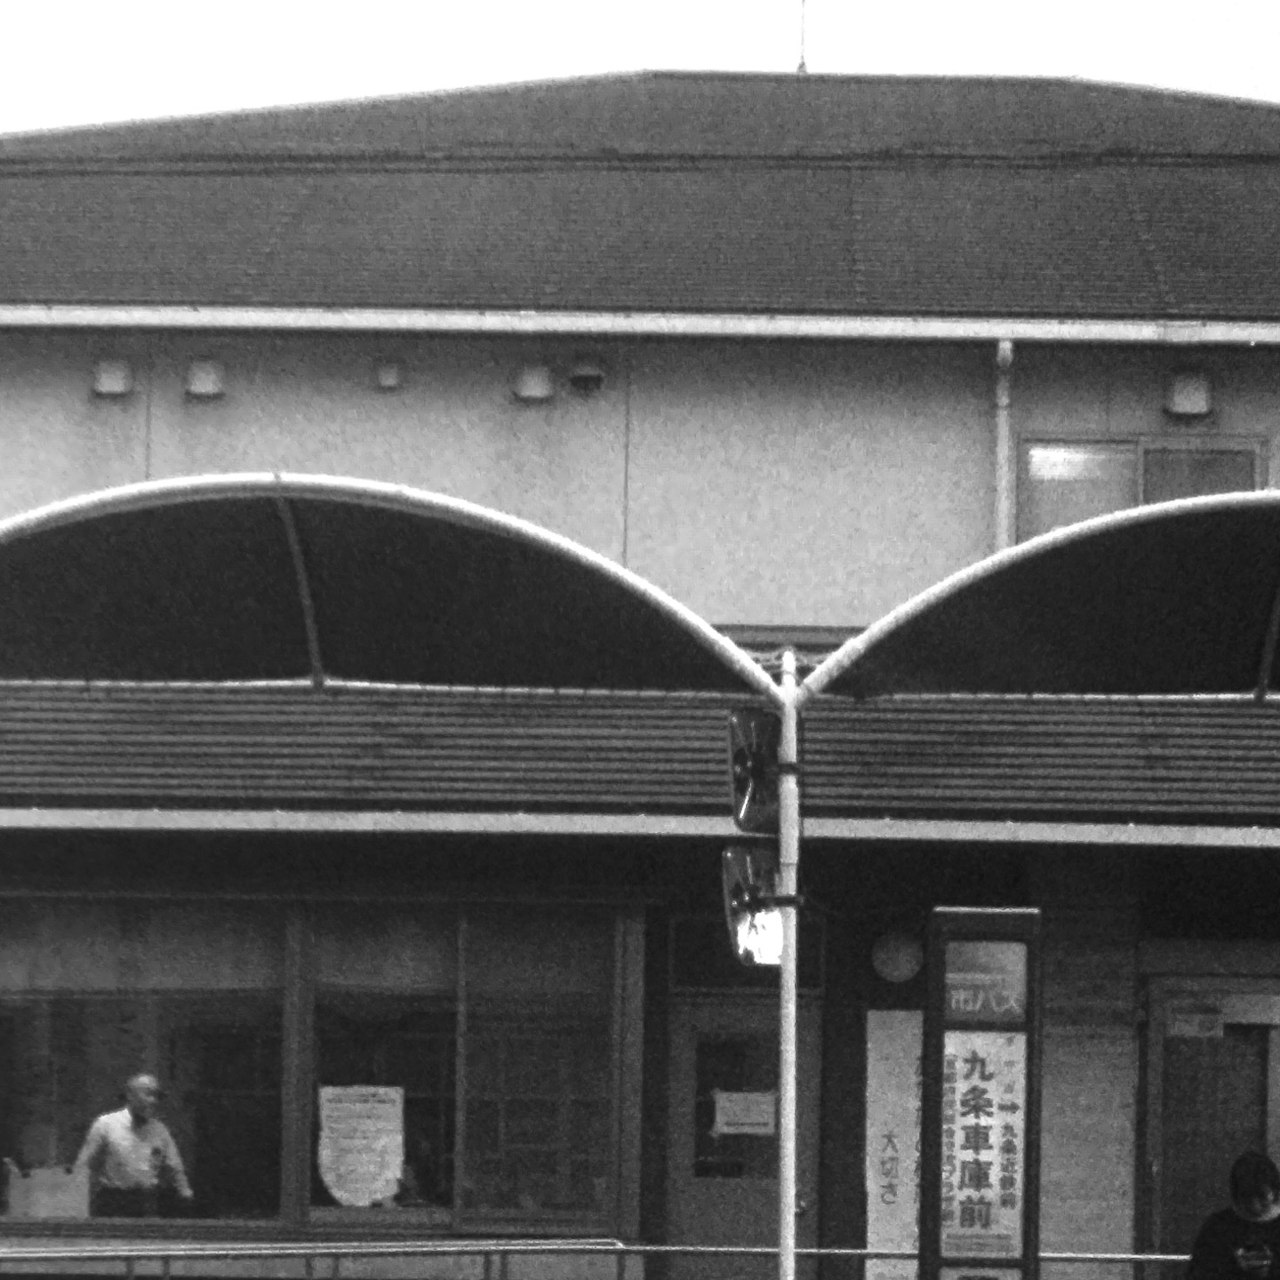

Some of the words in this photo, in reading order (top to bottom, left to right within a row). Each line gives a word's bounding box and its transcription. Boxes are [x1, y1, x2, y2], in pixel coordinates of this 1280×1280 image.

[951, 989, 1023, 1013] 市バス
[958, 1050, 994, 1229] 九条車庫前
